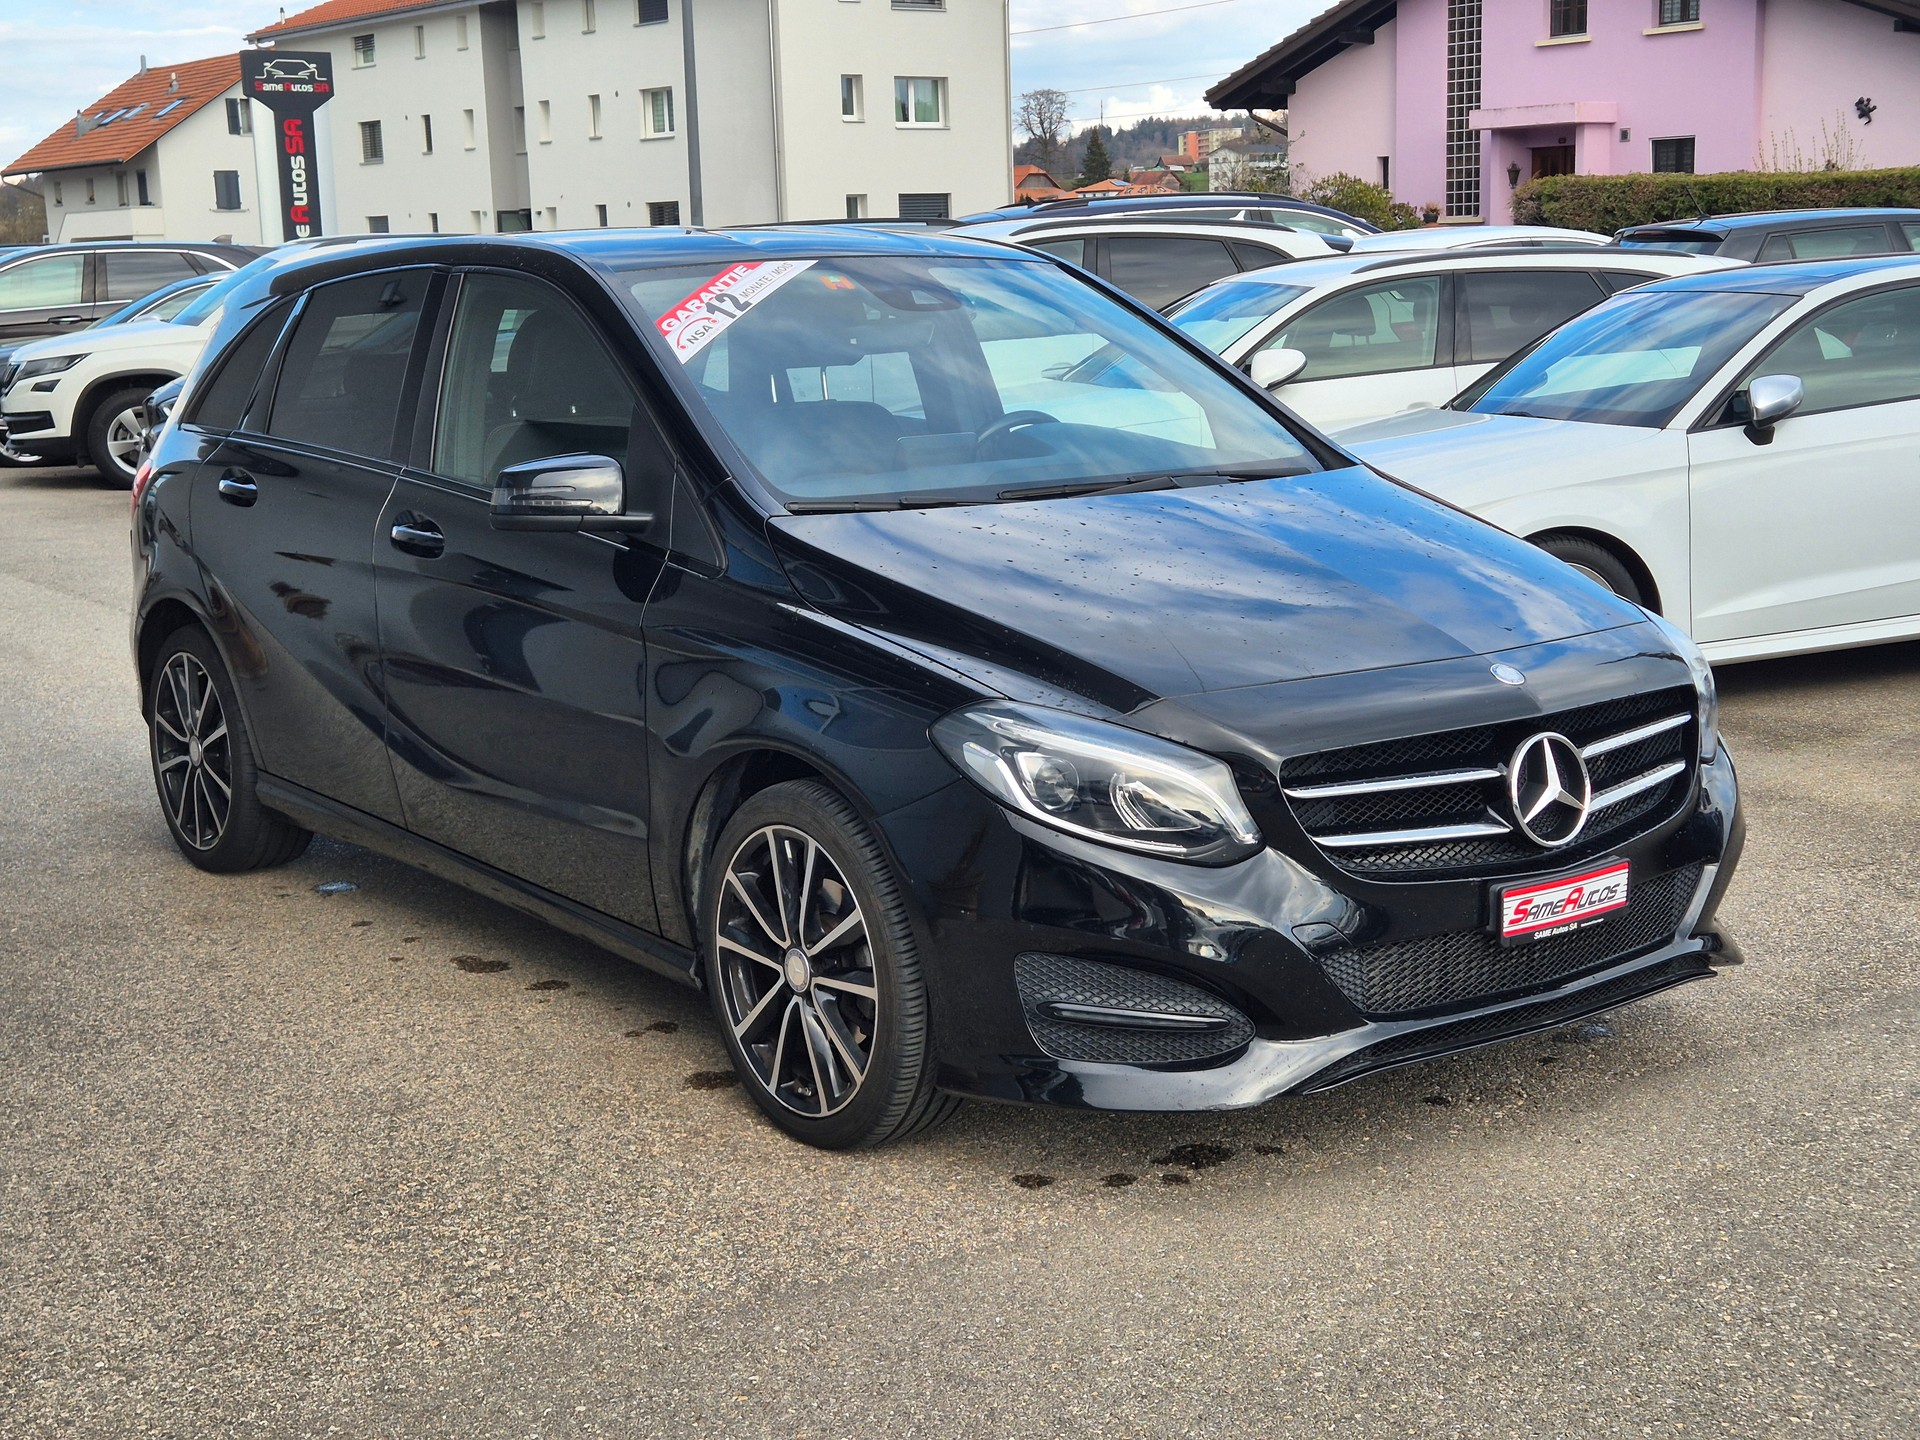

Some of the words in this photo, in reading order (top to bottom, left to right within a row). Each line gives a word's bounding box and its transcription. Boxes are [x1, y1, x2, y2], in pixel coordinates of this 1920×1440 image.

[661, 265, 750, 332] GARANTIE
[705, 292, 753, 320] 12
[739, 275, 773, 299] MONATE
[771, 262, 794, 276] MOIS
[686, 324, 713, 345] NSA
[1533, 929, 1553, 940] SAME
[1552, 925, 1569, 936] Autos
[1569, 922, 1578, 931] SA
